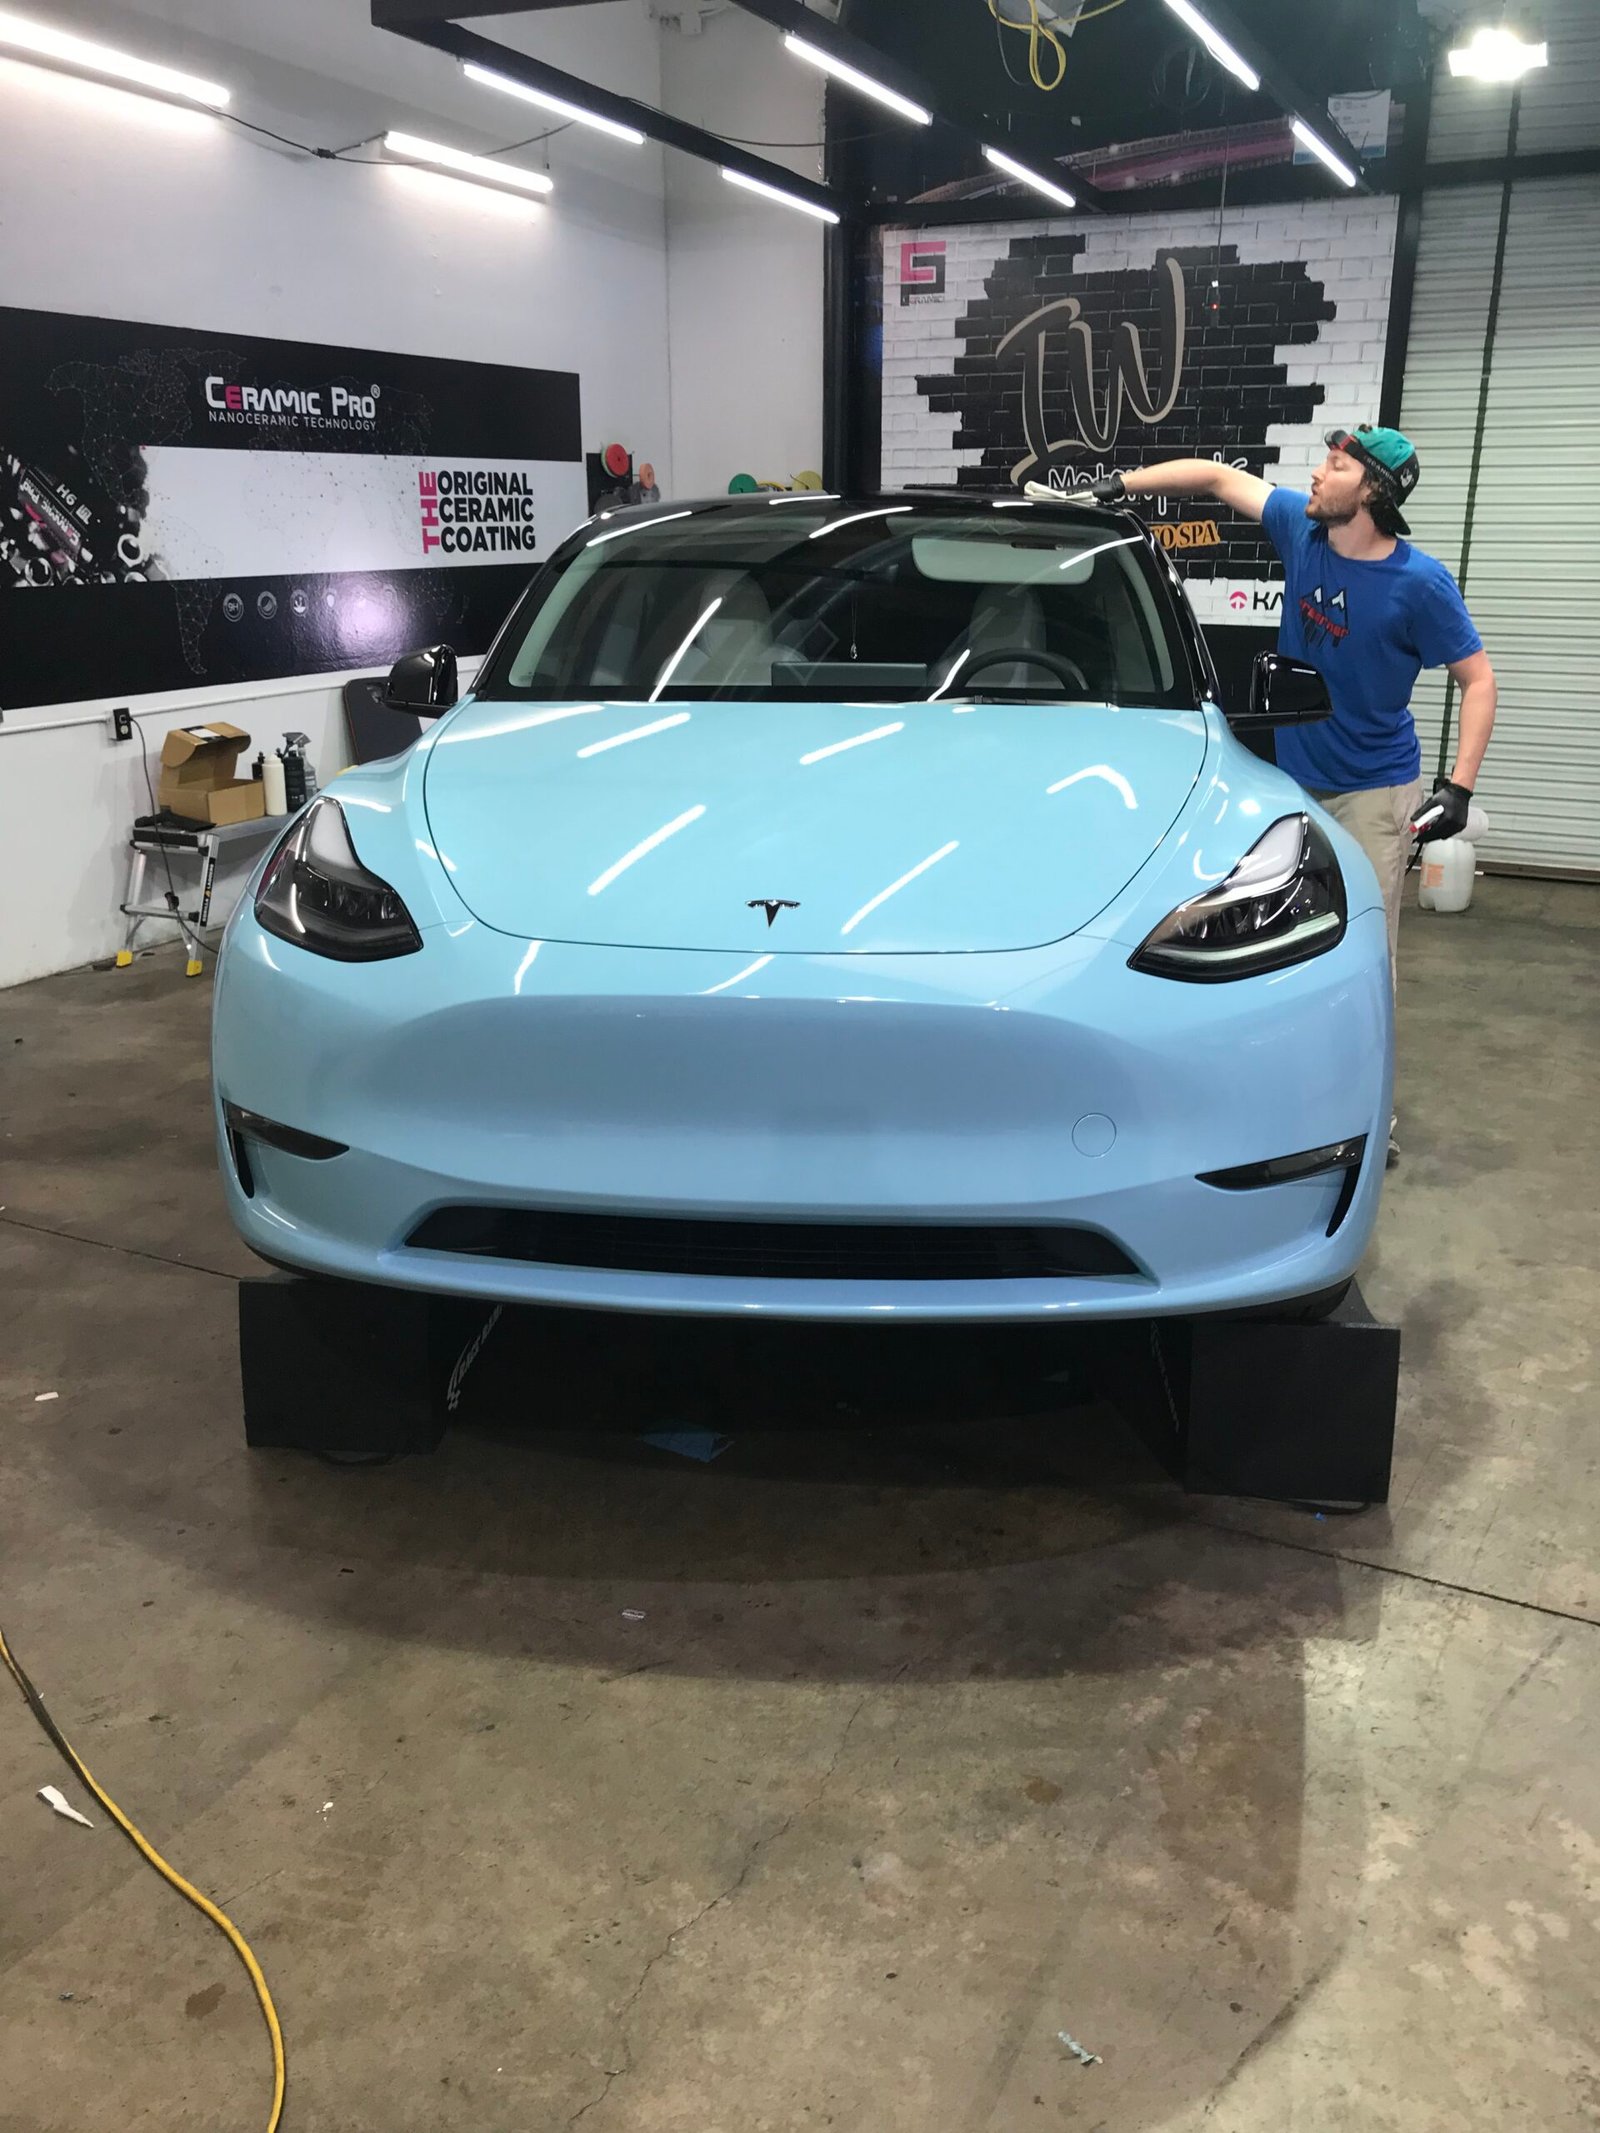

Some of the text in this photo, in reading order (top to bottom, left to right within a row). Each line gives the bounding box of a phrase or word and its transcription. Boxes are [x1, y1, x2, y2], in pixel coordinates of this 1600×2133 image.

[205, 376, 322, 415] CERAMIC
[208, 410, 377, 431] NANOCERAMIC TECHNOLOGY
[437, 470, 533, 496] ORIGINAL
[418, 471, 440, 554] THE
[439, 497, 535, 523] CERAMIC
[441, 525, 536, 553] COATING
[1179, 523, 1216, 546] SPA
